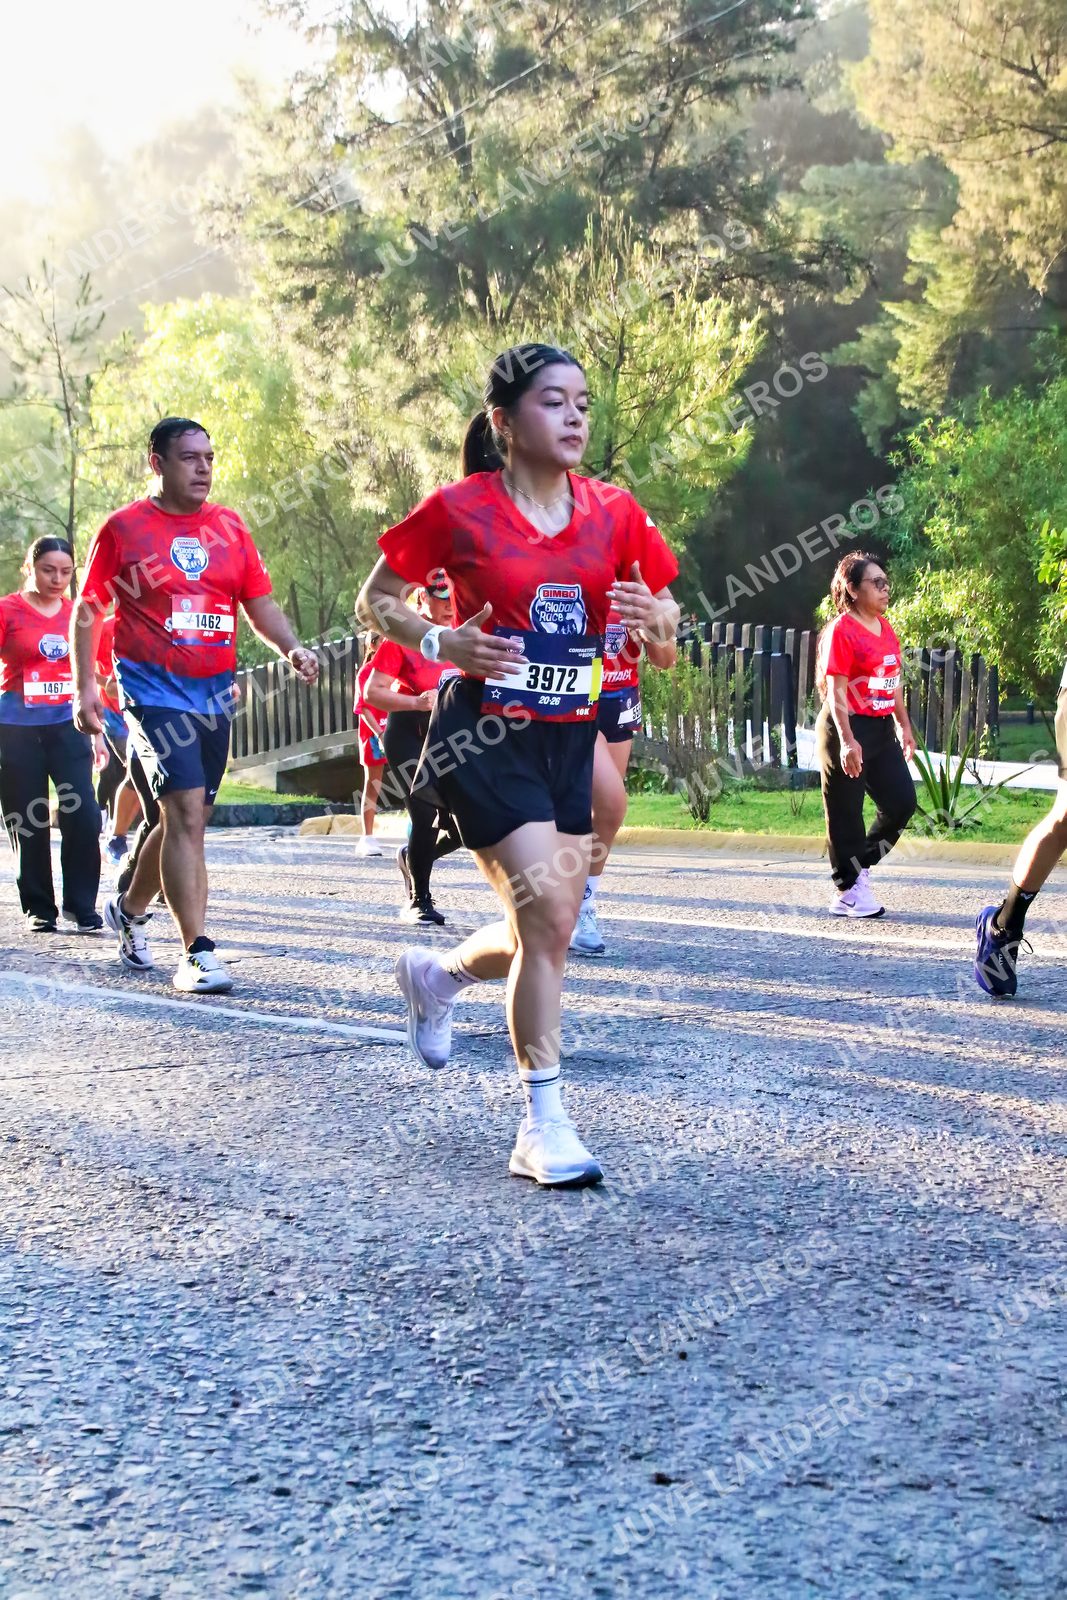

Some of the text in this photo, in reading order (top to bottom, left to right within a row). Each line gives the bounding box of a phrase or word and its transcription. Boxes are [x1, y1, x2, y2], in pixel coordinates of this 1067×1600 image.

[542, 590, 576, 598] BIMBO
[544, 601, 575, 613] Global
[196, 614, 221, 630] 1462
[539, 610, 564, 622] Race
[526, 665, 578, 692] 3972
[43, 682, 64, 694] 1467
[575, 708, 590, 716] 10K
